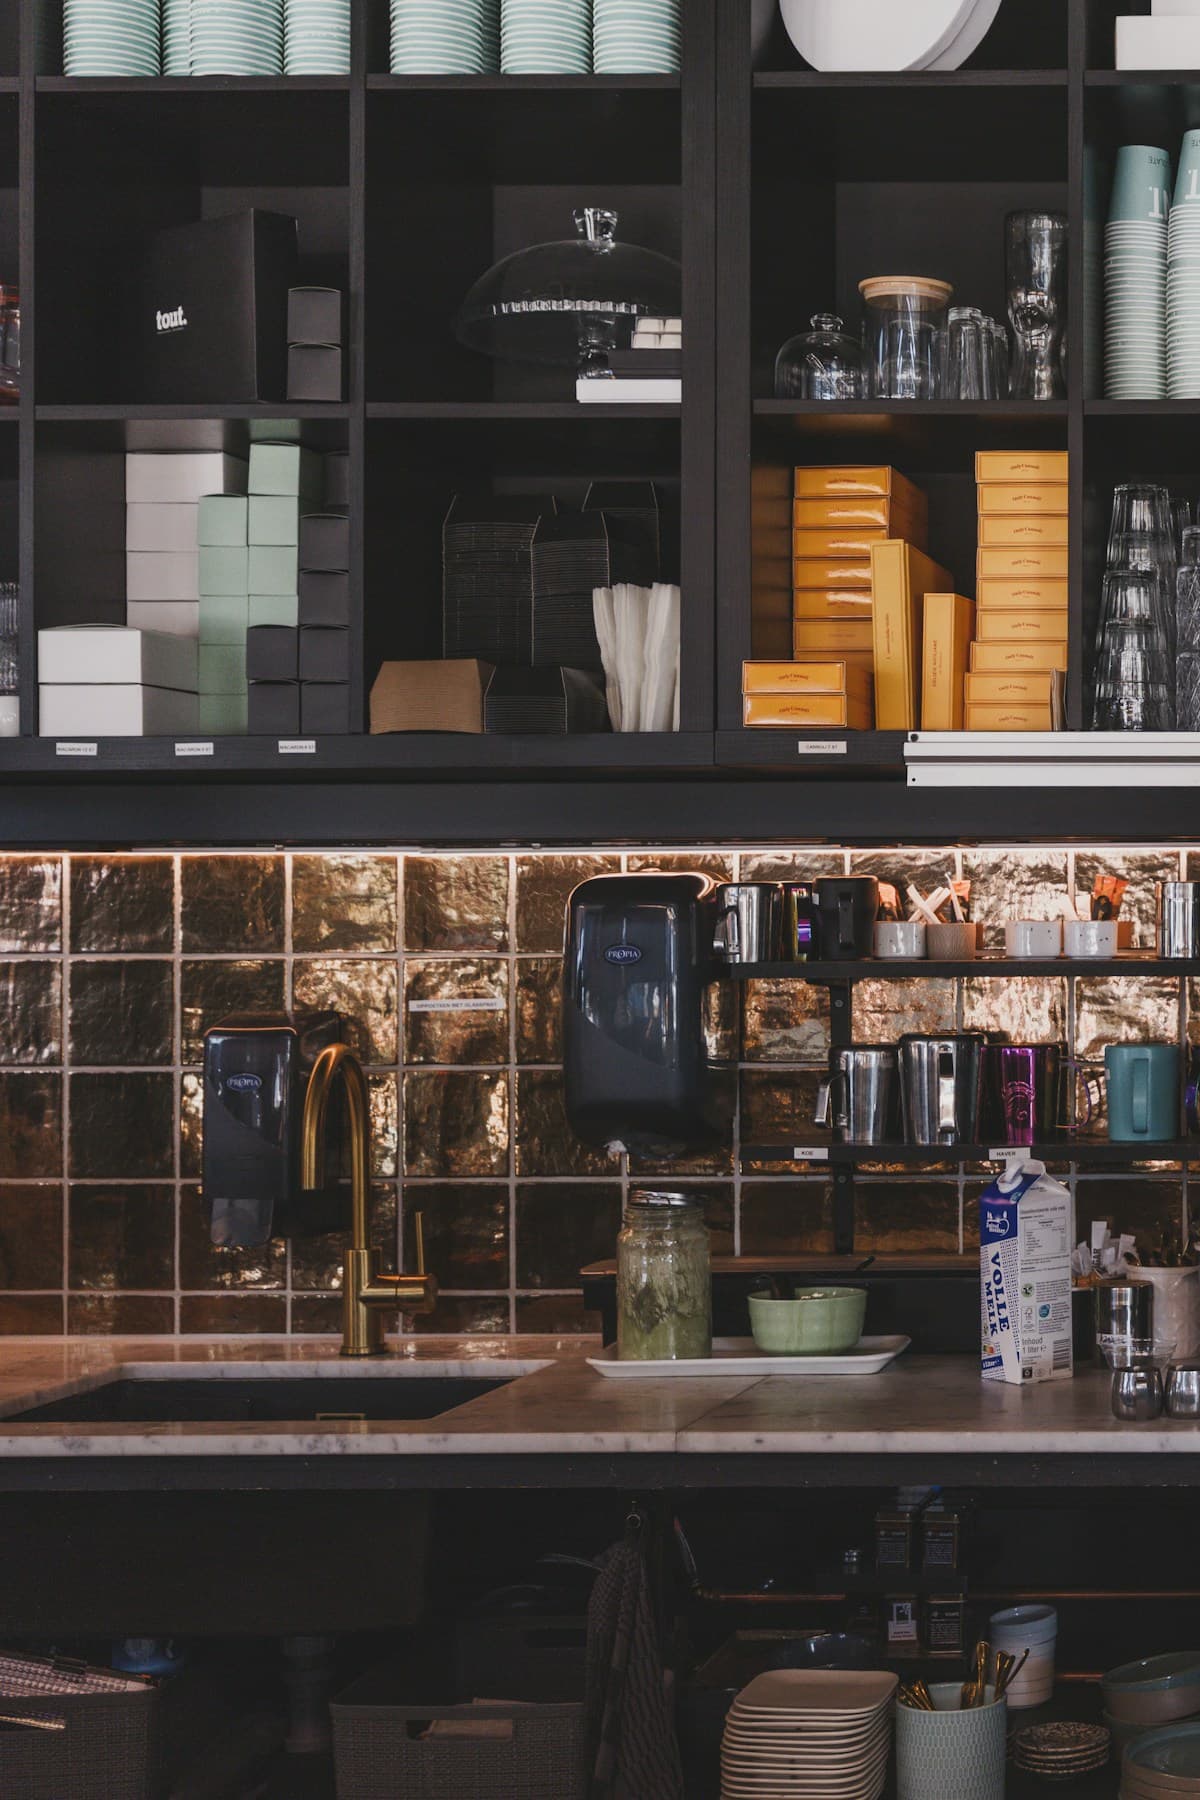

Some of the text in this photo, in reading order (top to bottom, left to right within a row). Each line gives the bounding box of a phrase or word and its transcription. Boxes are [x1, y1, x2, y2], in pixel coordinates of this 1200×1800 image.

[156, 304, 188, 331] tout.
[227, 1077, 260, 1088] PROPIA
[991, 1251, 1010, 1332] VOLLE
[985, 1281, 998, 1337] MELK
[1021, 1337, 1043, 1346] Inhoud
